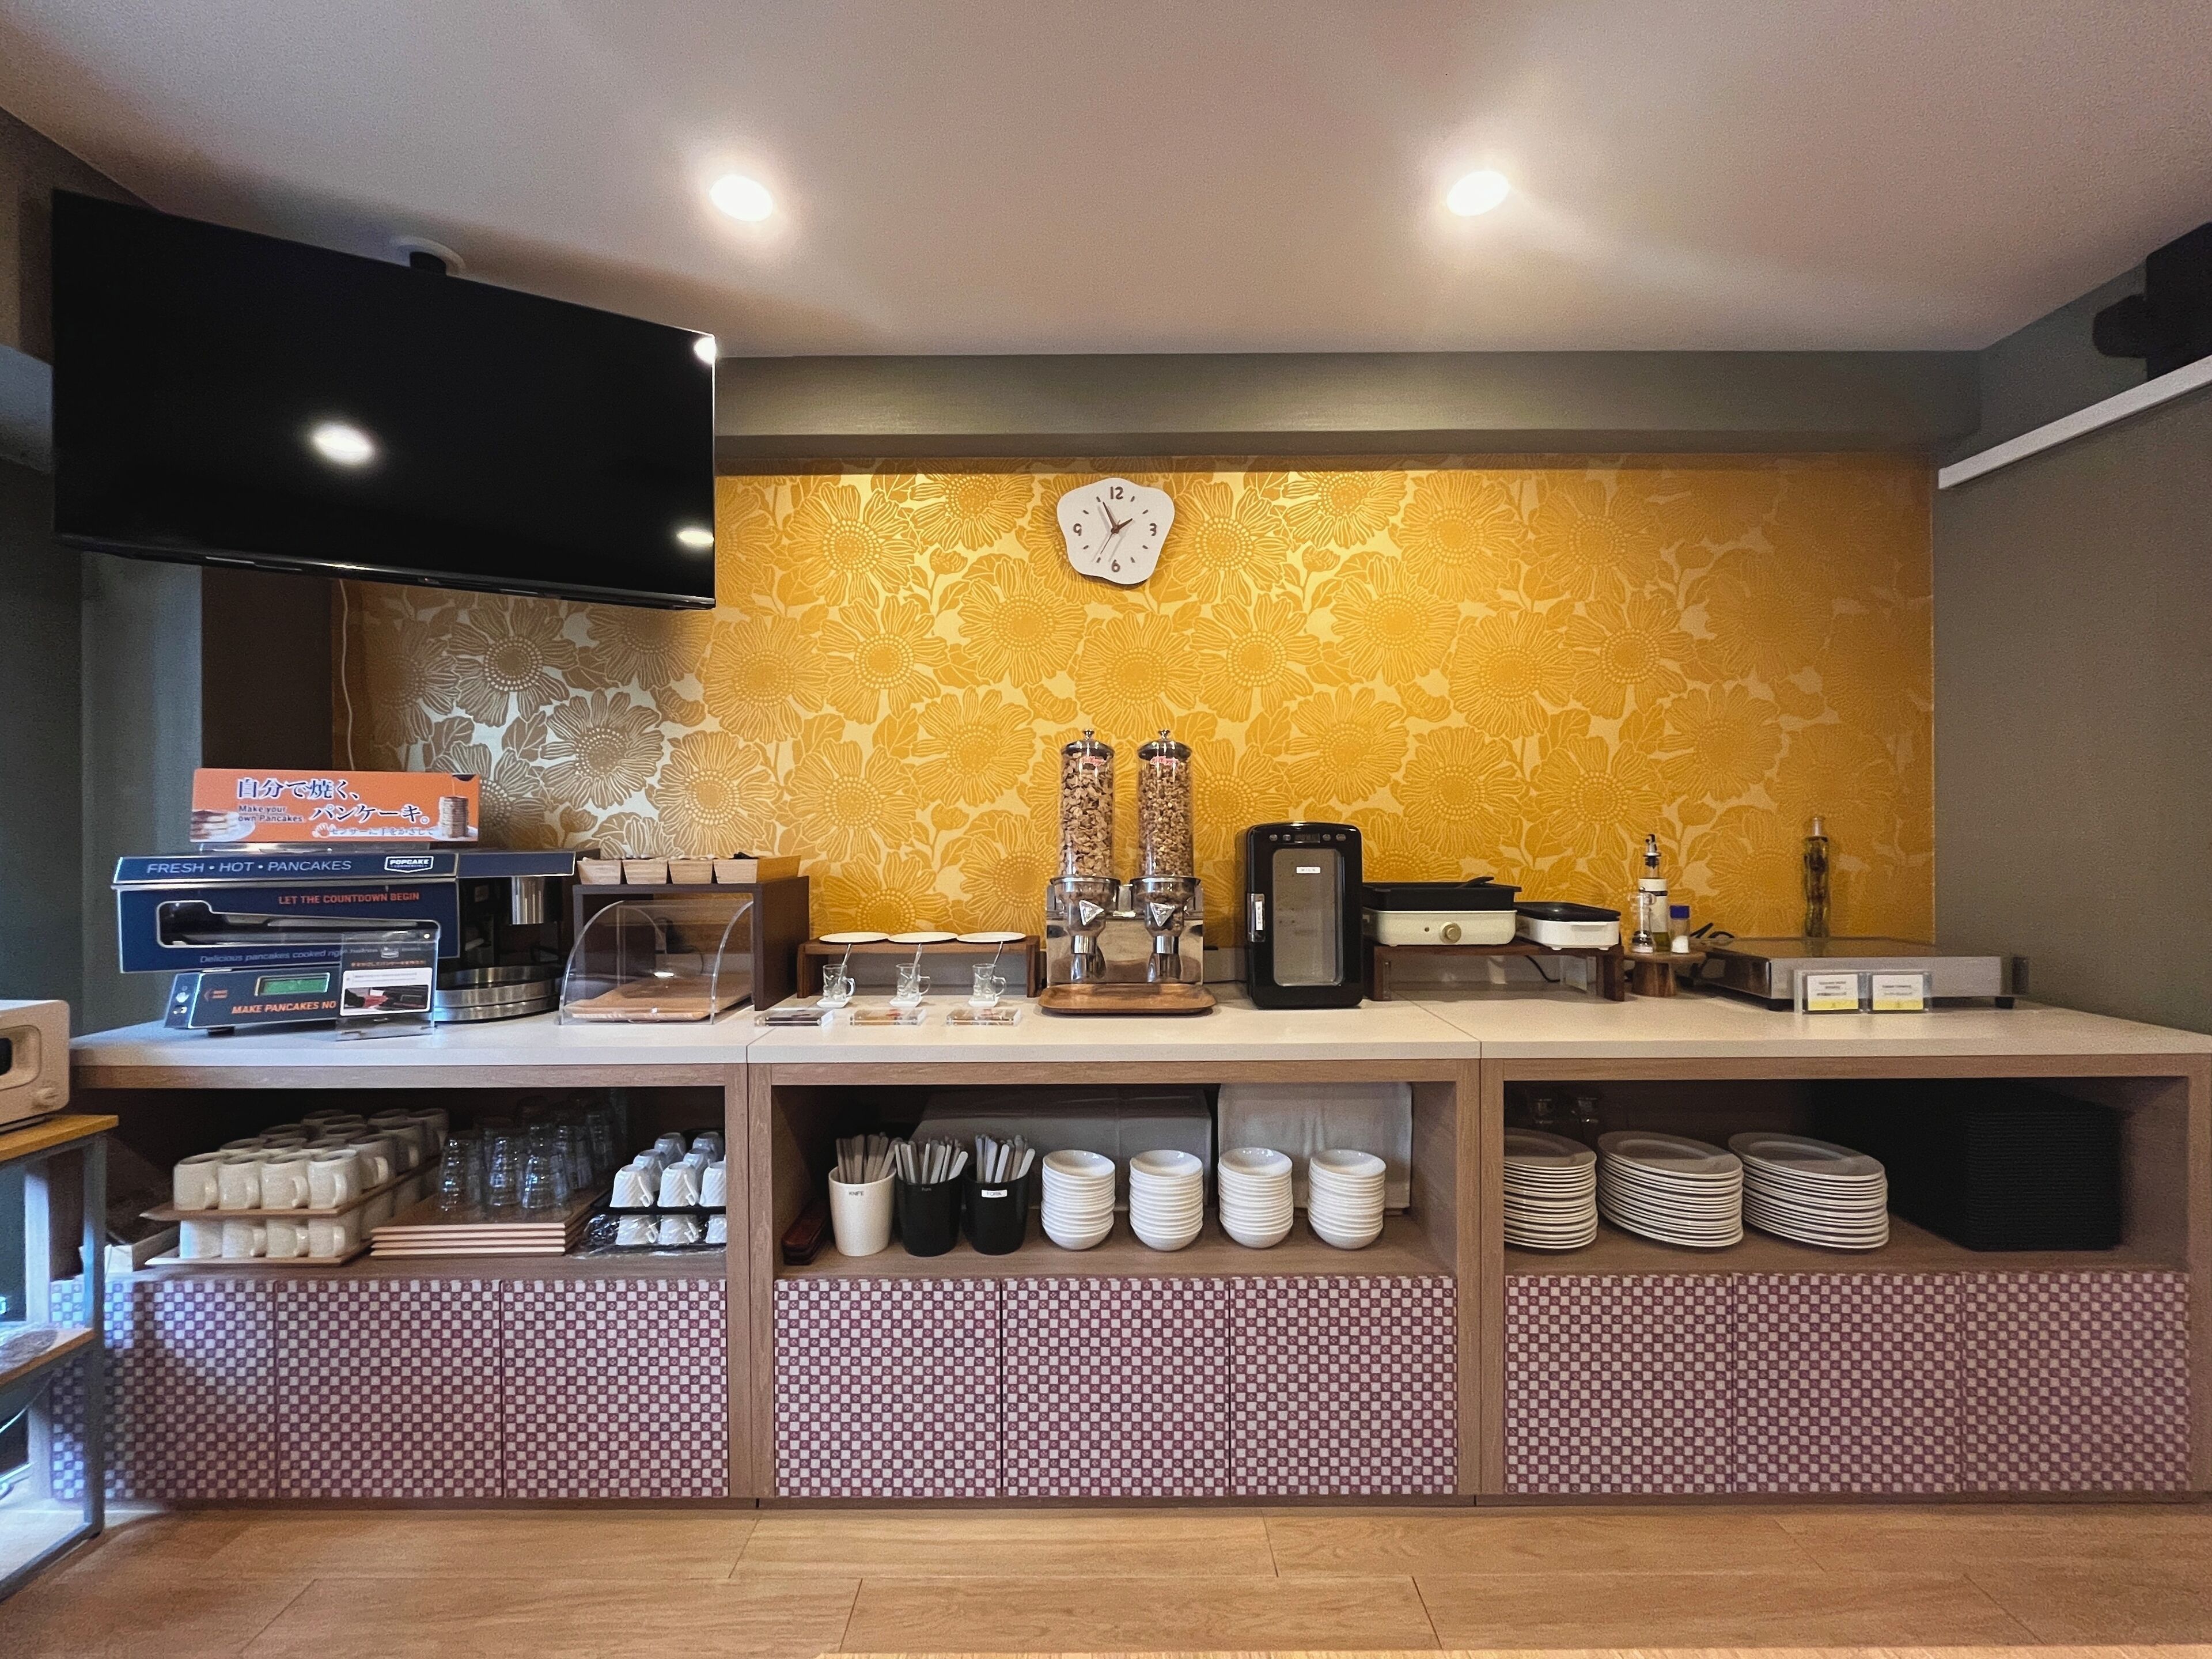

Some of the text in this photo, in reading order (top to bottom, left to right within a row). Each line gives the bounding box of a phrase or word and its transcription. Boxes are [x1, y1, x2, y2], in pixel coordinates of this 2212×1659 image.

[1110, 486, 1124, 499] 12
[1073, 523, 1082, 536] 9
[1150, 523, 1157, 536] 3
[1111, 559, 1120, 573] 6
[237, 778, 361, 800] 自分で焼く、
[266, 806, 286, 815] your
[310, 804, 430, 824] パンケーキ。
[146, 860, 352, 874] FRESH HOT PANCAKES
[279, 892, 419, 904] LET THE COUNTDOWN BEGIN
[200, 955, 243, 963] Delicious
[245, 952, 290, 963] pancakes
[293, 950, 325, 959] cooked
[232, 1001, 336, 1014] MAKE PANCAKES NO
